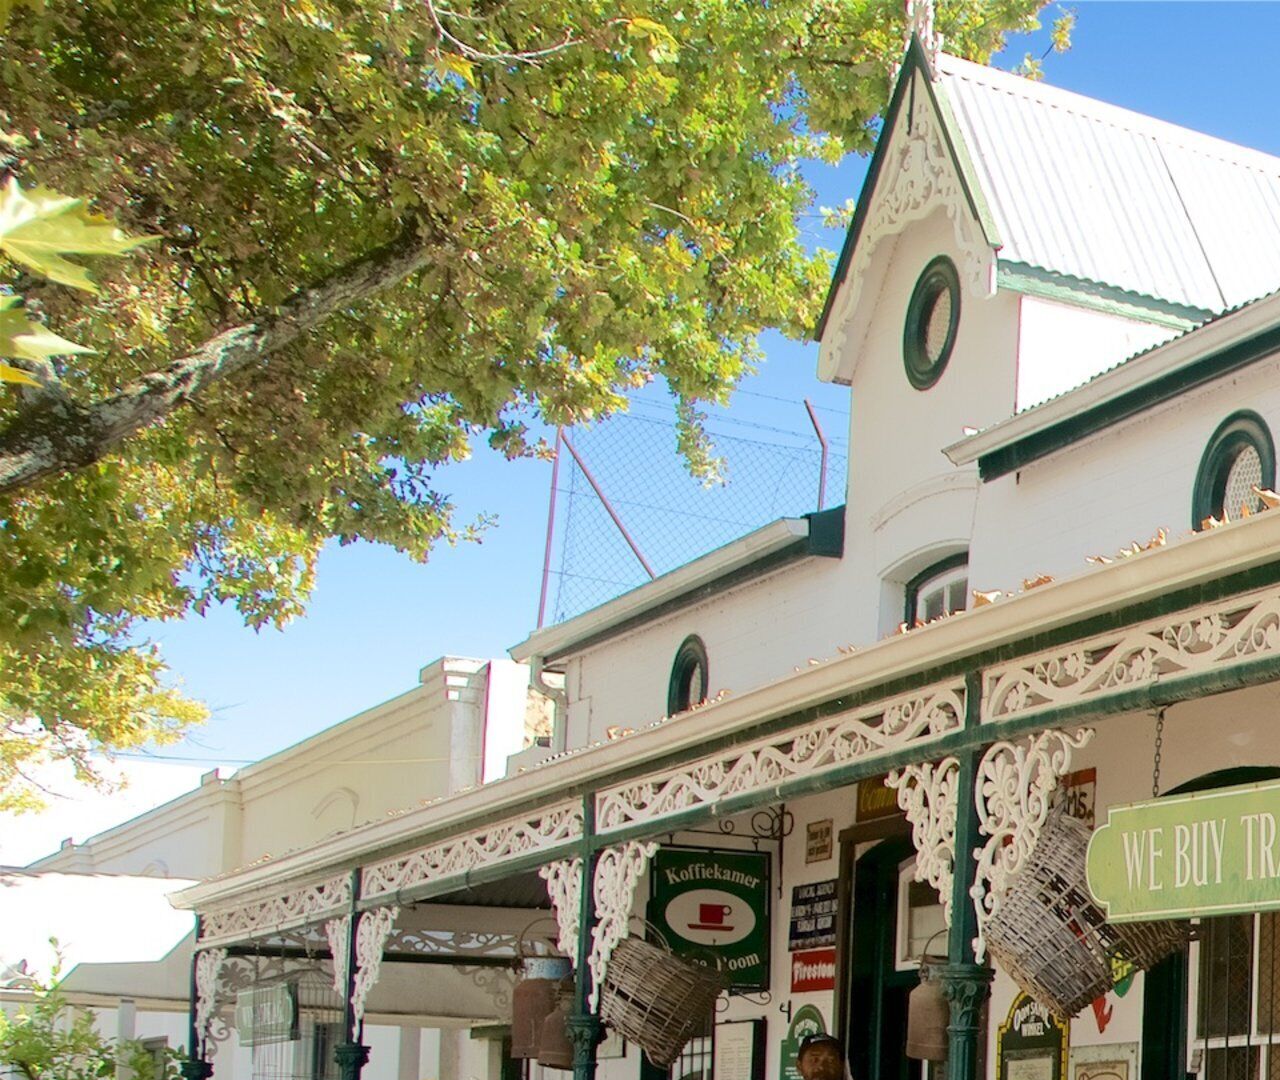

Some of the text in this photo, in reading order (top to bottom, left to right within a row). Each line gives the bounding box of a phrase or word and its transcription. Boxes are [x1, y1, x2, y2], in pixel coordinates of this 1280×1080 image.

[664, 863, 760, 890] Koffiekamer
[1122, 827, 1163, 892] WE
[1174, 820, 1227, 886] BUY
